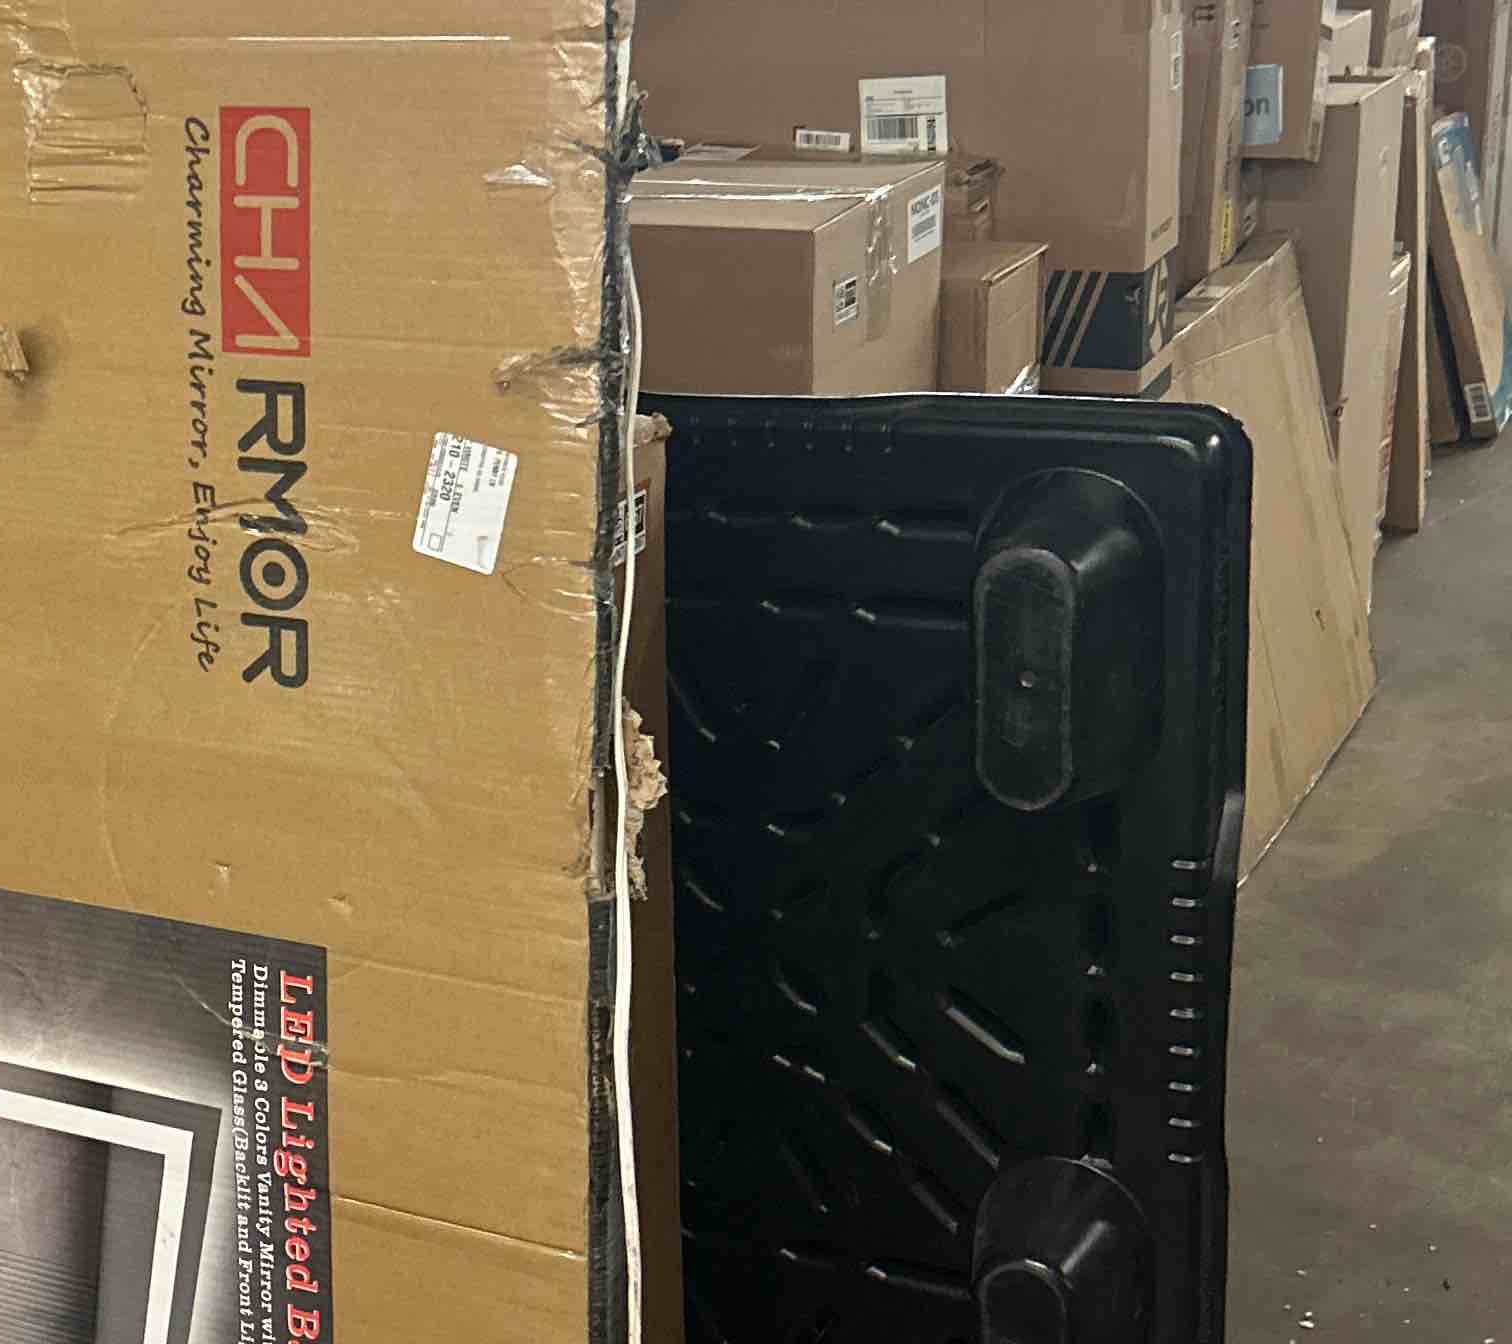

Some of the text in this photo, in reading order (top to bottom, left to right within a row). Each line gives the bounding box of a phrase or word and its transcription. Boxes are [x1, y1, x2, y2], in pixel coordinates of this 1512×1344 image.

[181, 116, 223, 673] Charming Mirror, Enjoy Life
[225, 956, 249, 1067] Tempered
[275, 967, 316, 1087] LED
[253, 1095, 271, 1167] Colors
[252, 1169, 274, 1236] Vanity
[274, 1093, 320, 1293] Lighted
[234, 1213, 254, 1254] and
[234, 1257, 255, 1318] Front
[257, 1240, 276, 1313] Mirror
